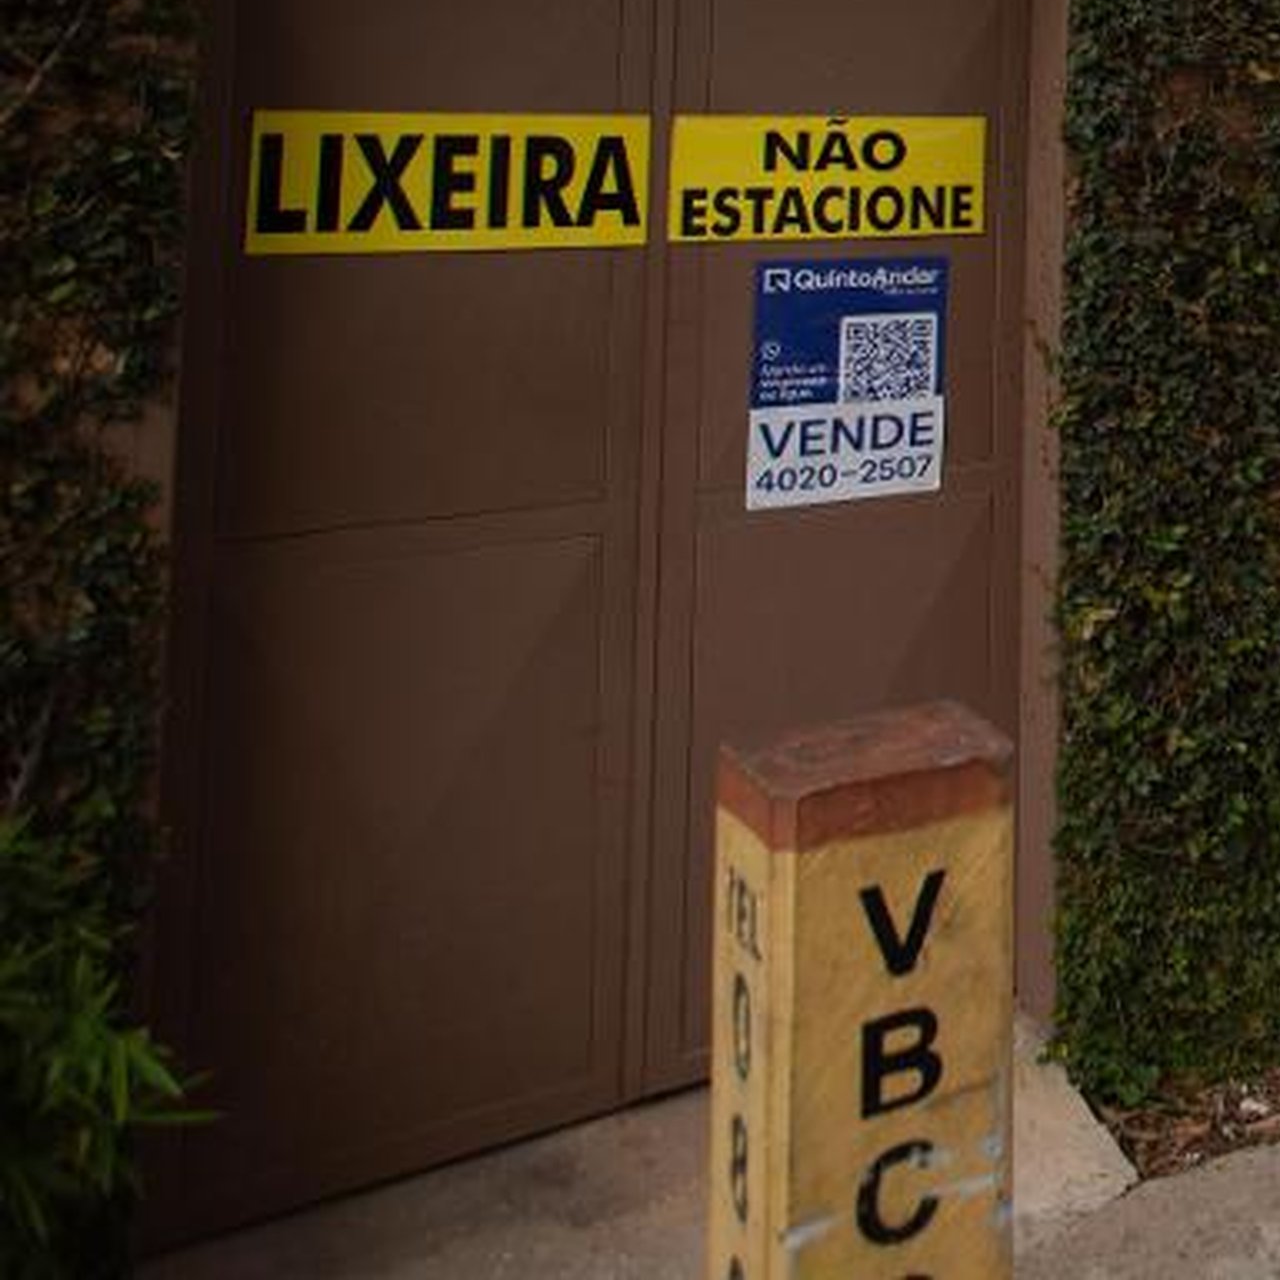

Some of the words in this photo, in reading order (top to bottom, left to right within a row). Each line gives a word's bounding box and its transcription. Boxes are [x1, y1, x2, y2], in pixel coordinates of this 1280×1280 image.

[763, 118, 908, 172] NÃO
[256, 133, 641, 233] LIXEIRA
[680, 186, 974, 236] ESTACIONE
[794, 266, 939, 290] QuintoAndar
[759, 411, 934, 459] VENDE
[756, 456, 932, 493] 4020-2507
